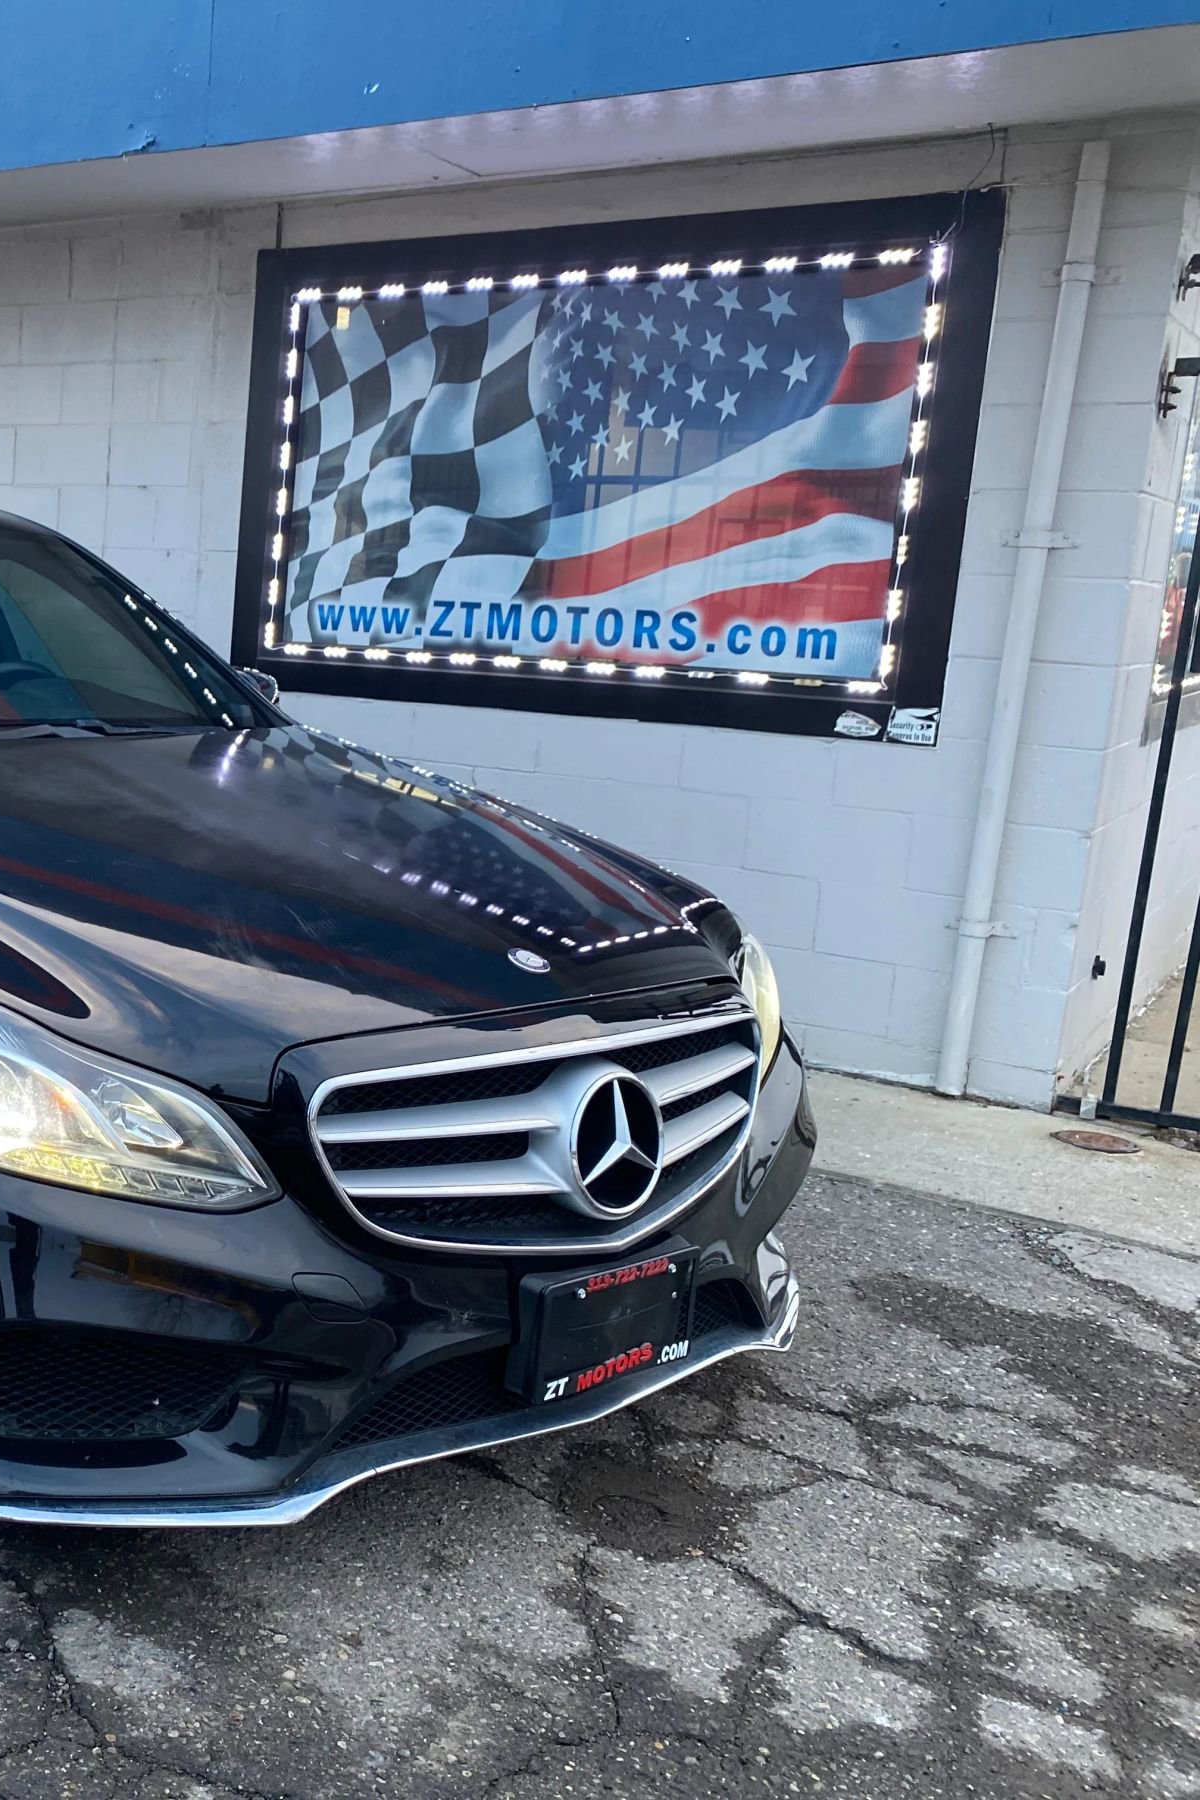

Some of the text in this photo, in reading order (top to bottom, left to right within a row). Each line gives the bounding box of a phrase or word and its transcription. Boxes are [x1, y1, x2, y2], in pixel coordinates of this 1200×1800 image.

[317, 600, 838, 660] www.ZTMOTORS.com
[544, 1340, 689, 1401] ZT MOTORS .COM
